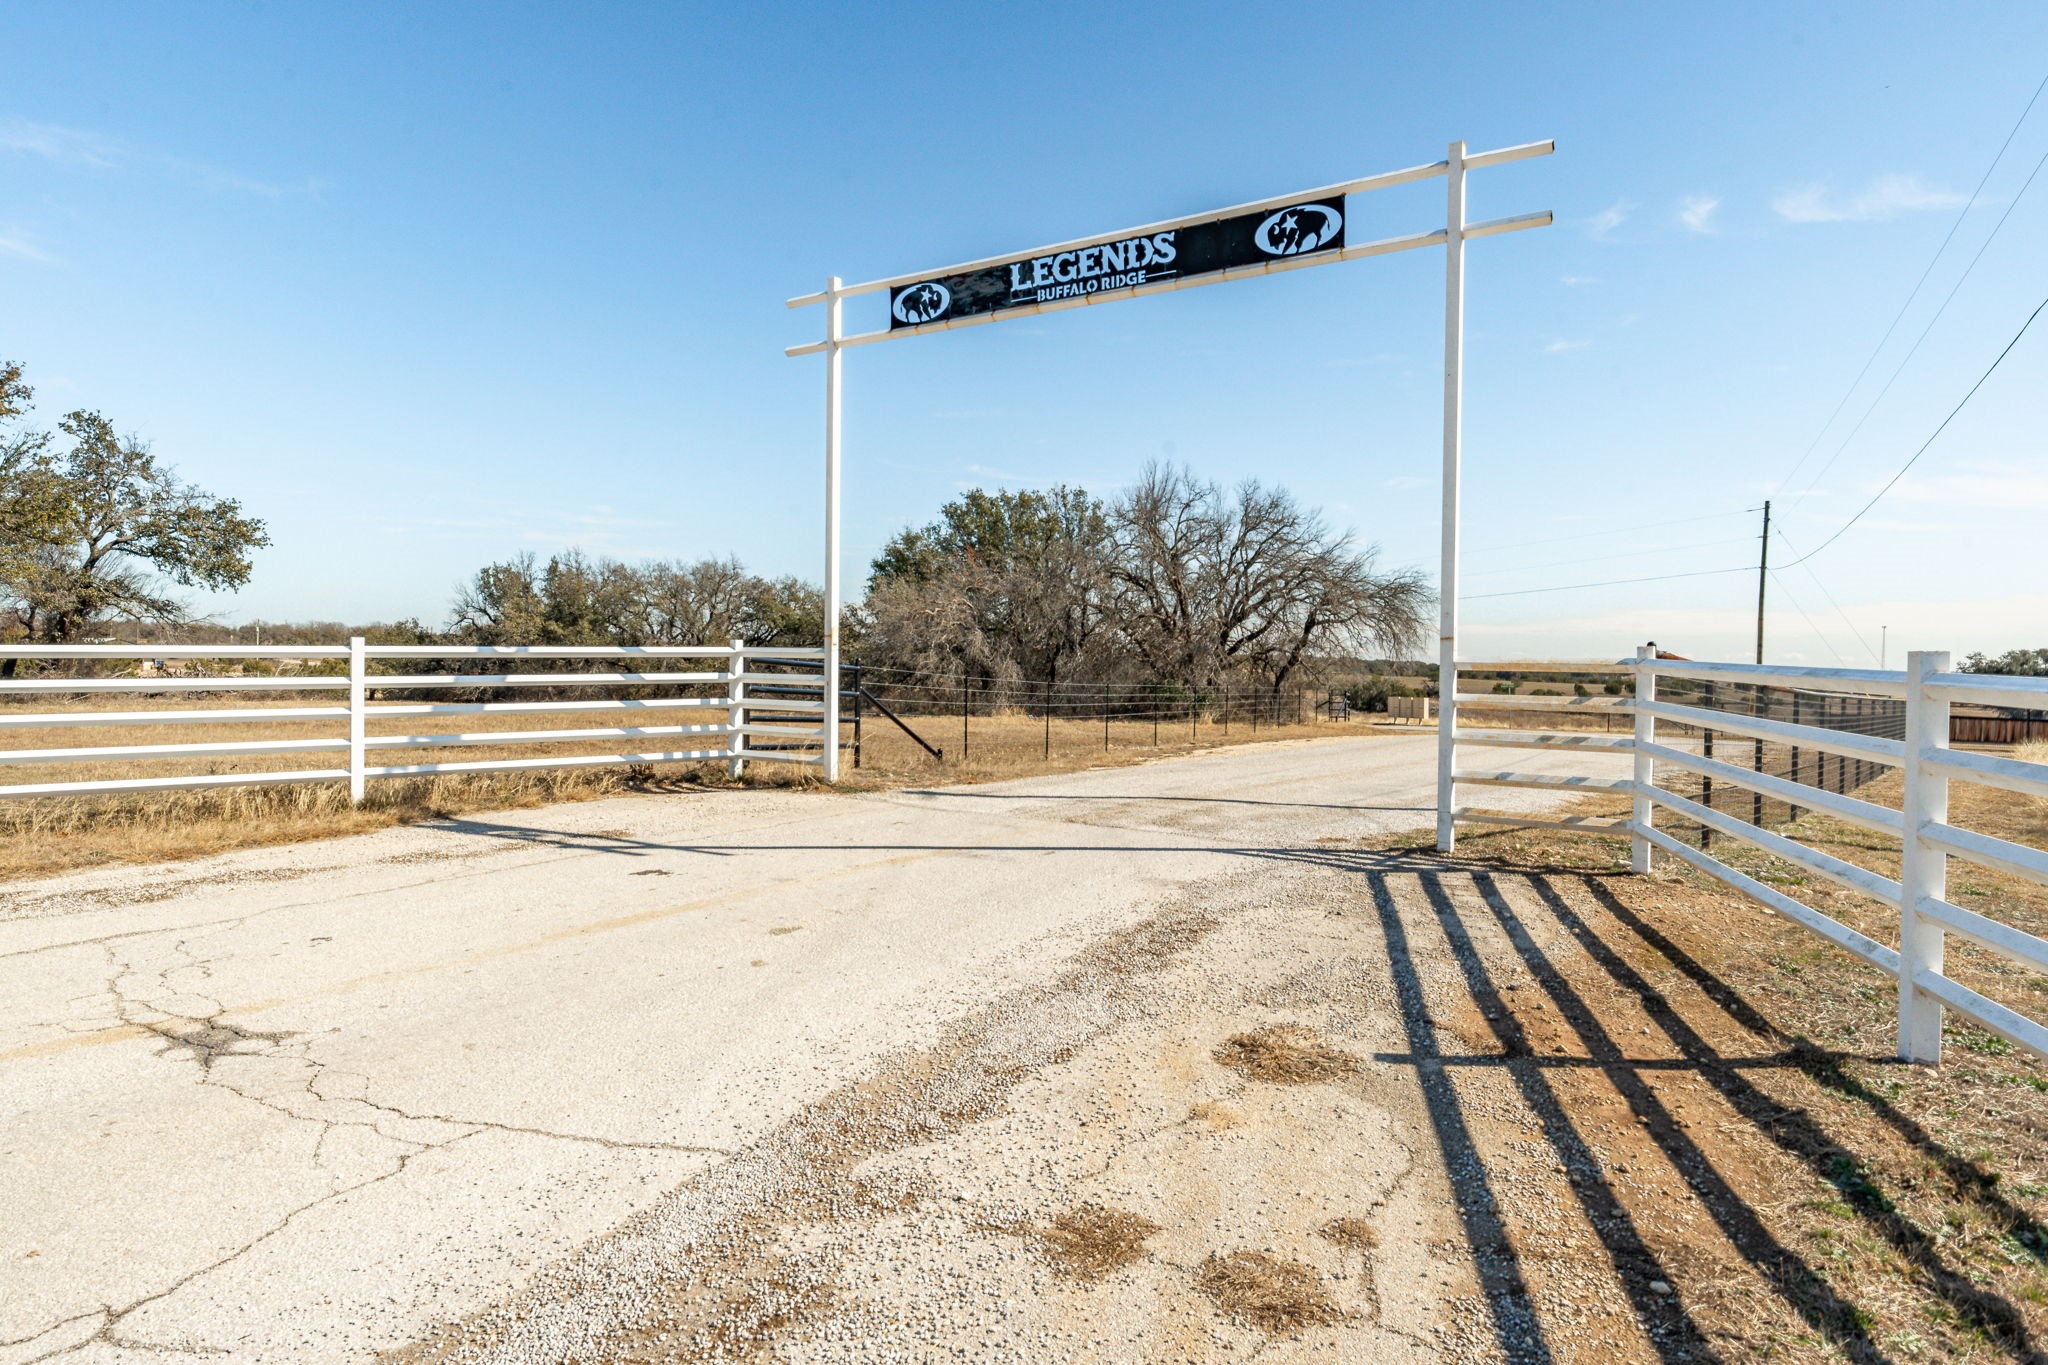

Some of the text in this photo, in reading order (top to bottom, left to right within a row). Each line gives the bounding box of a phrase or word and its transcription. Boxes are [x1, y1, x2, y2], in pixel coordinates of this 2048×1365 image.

[1010, 232, 1177, 291] LEGENDS
[1037, 270, 1146, 302] BUFFALO RIDGE
